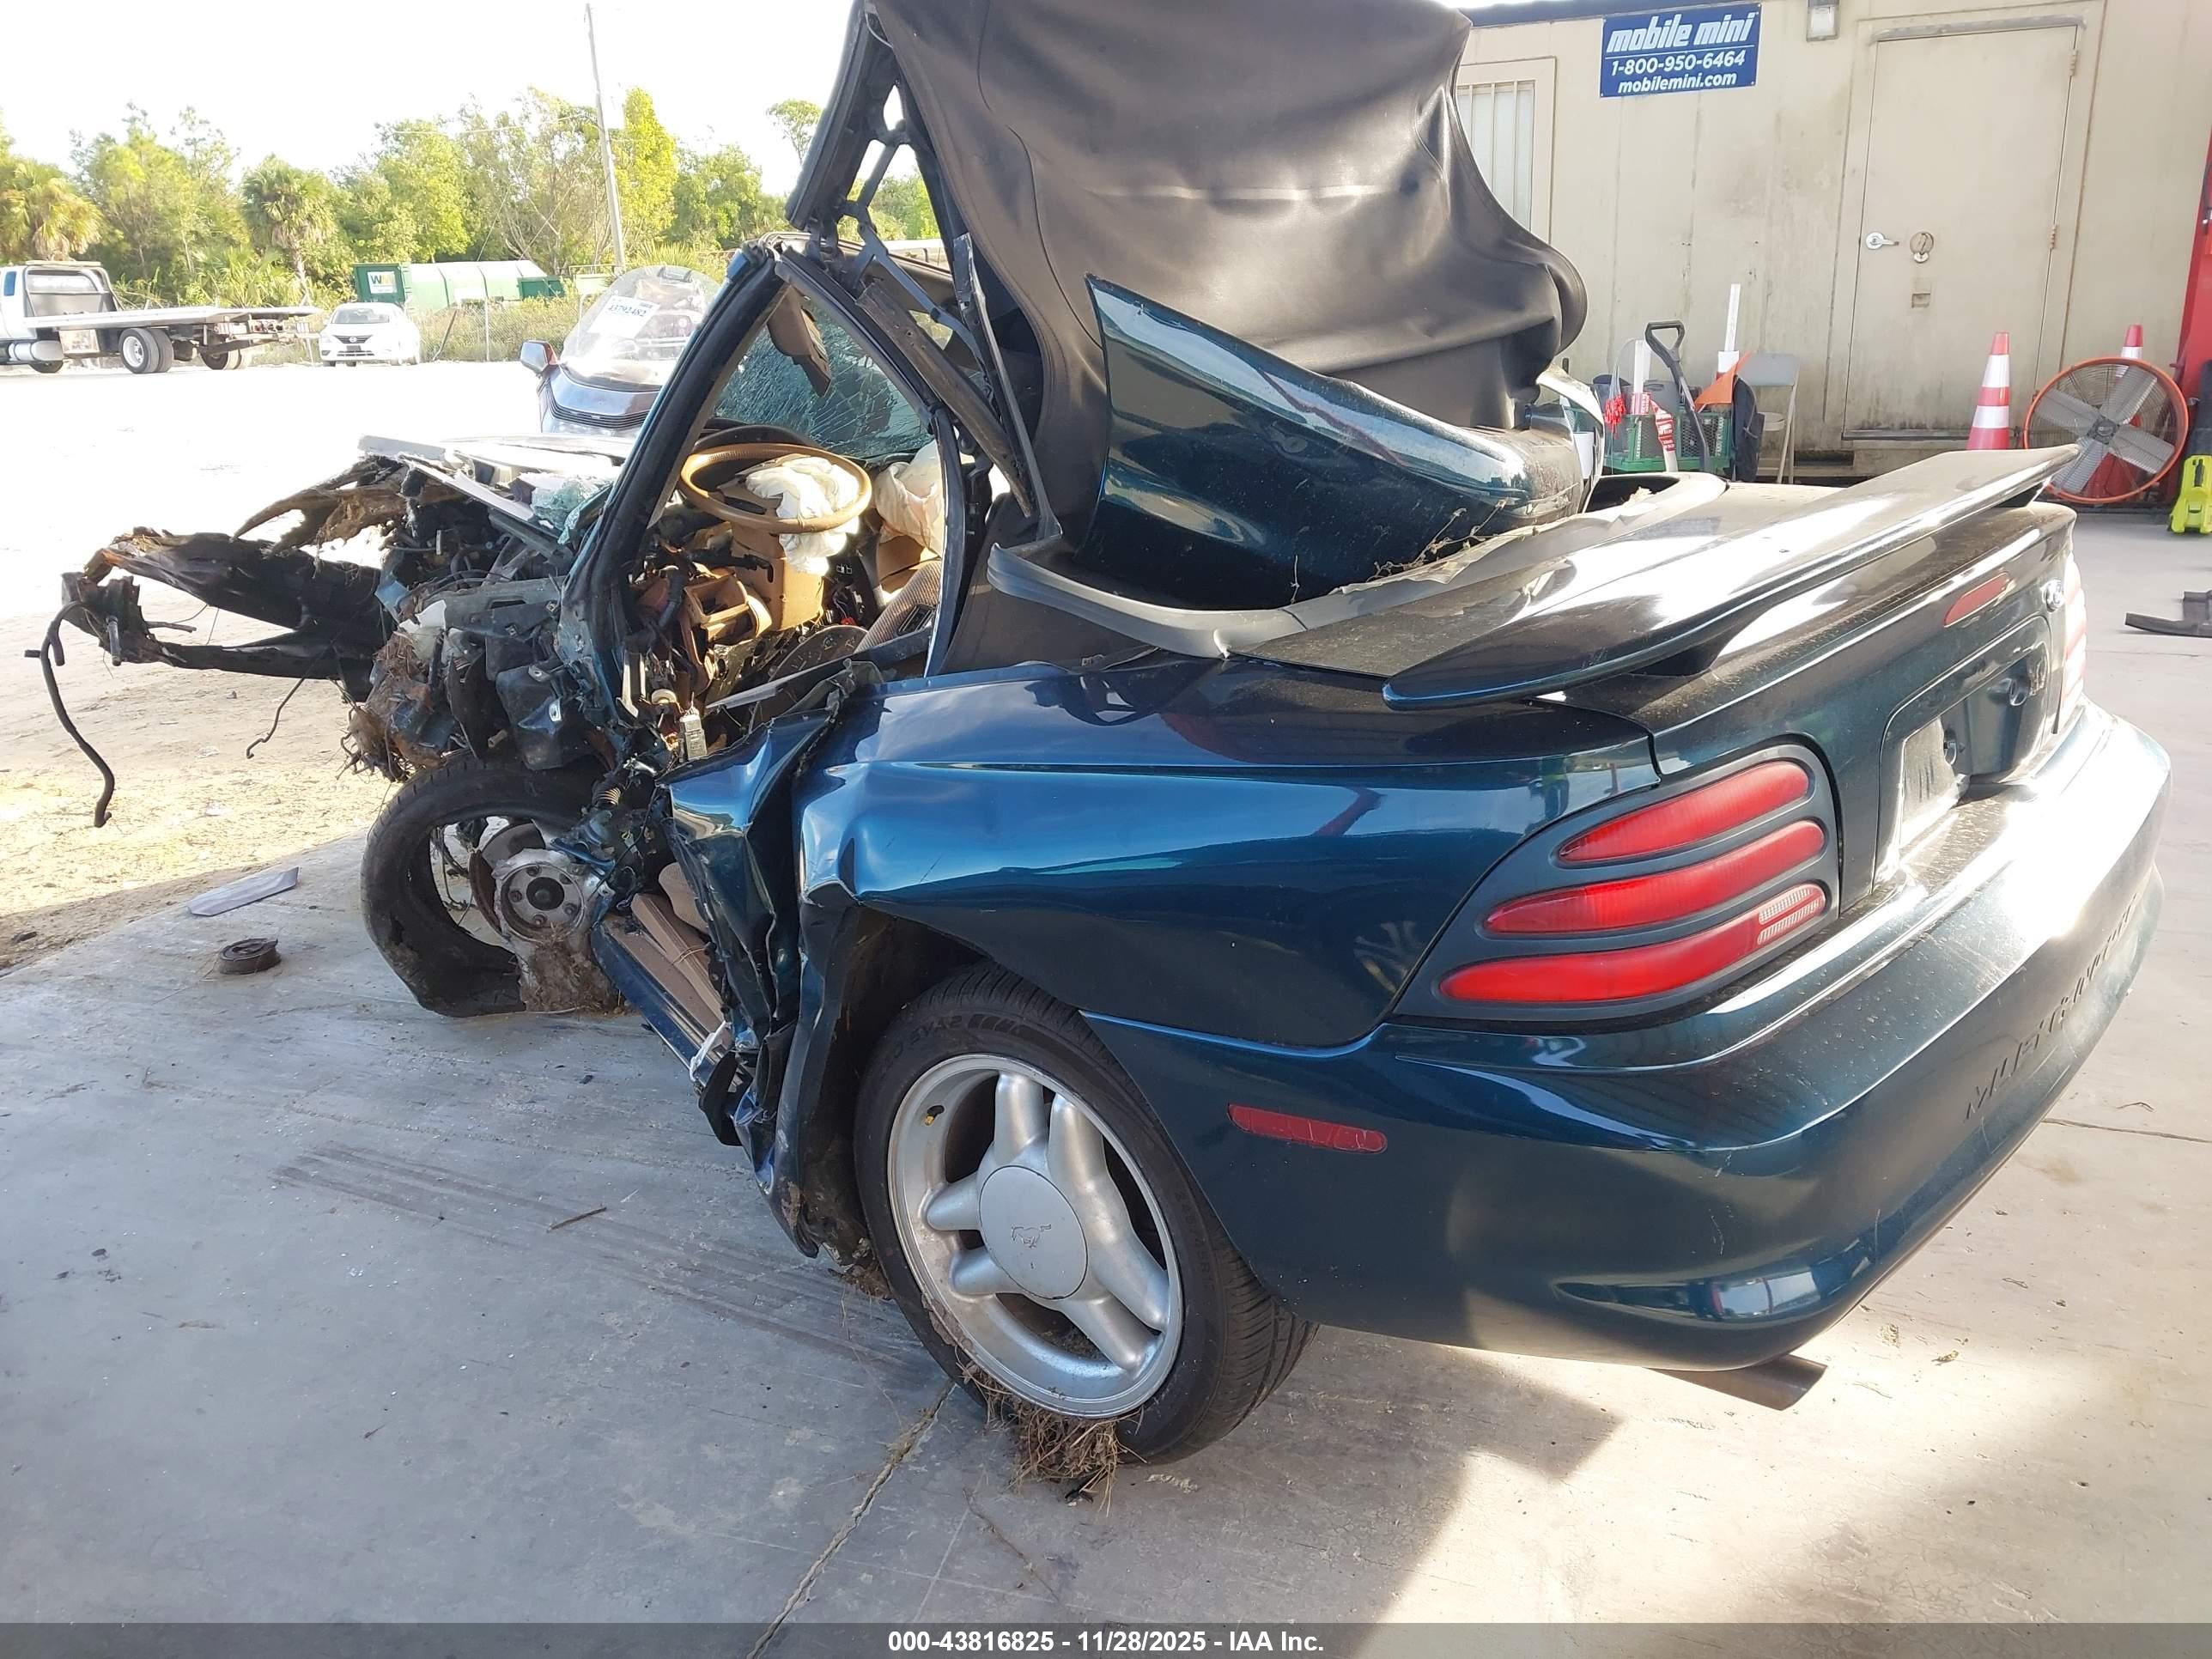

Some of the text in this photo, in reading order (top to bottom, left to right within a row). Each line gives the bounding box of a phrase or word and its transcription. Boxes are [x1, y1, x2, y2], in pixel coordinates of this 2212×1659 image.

[1606, 12, 1756, 52] mobile mini
[1611, 50, 1746, 76] 1-800-950-6464
[1618, 72, 1737, 94] mobilemini.com
